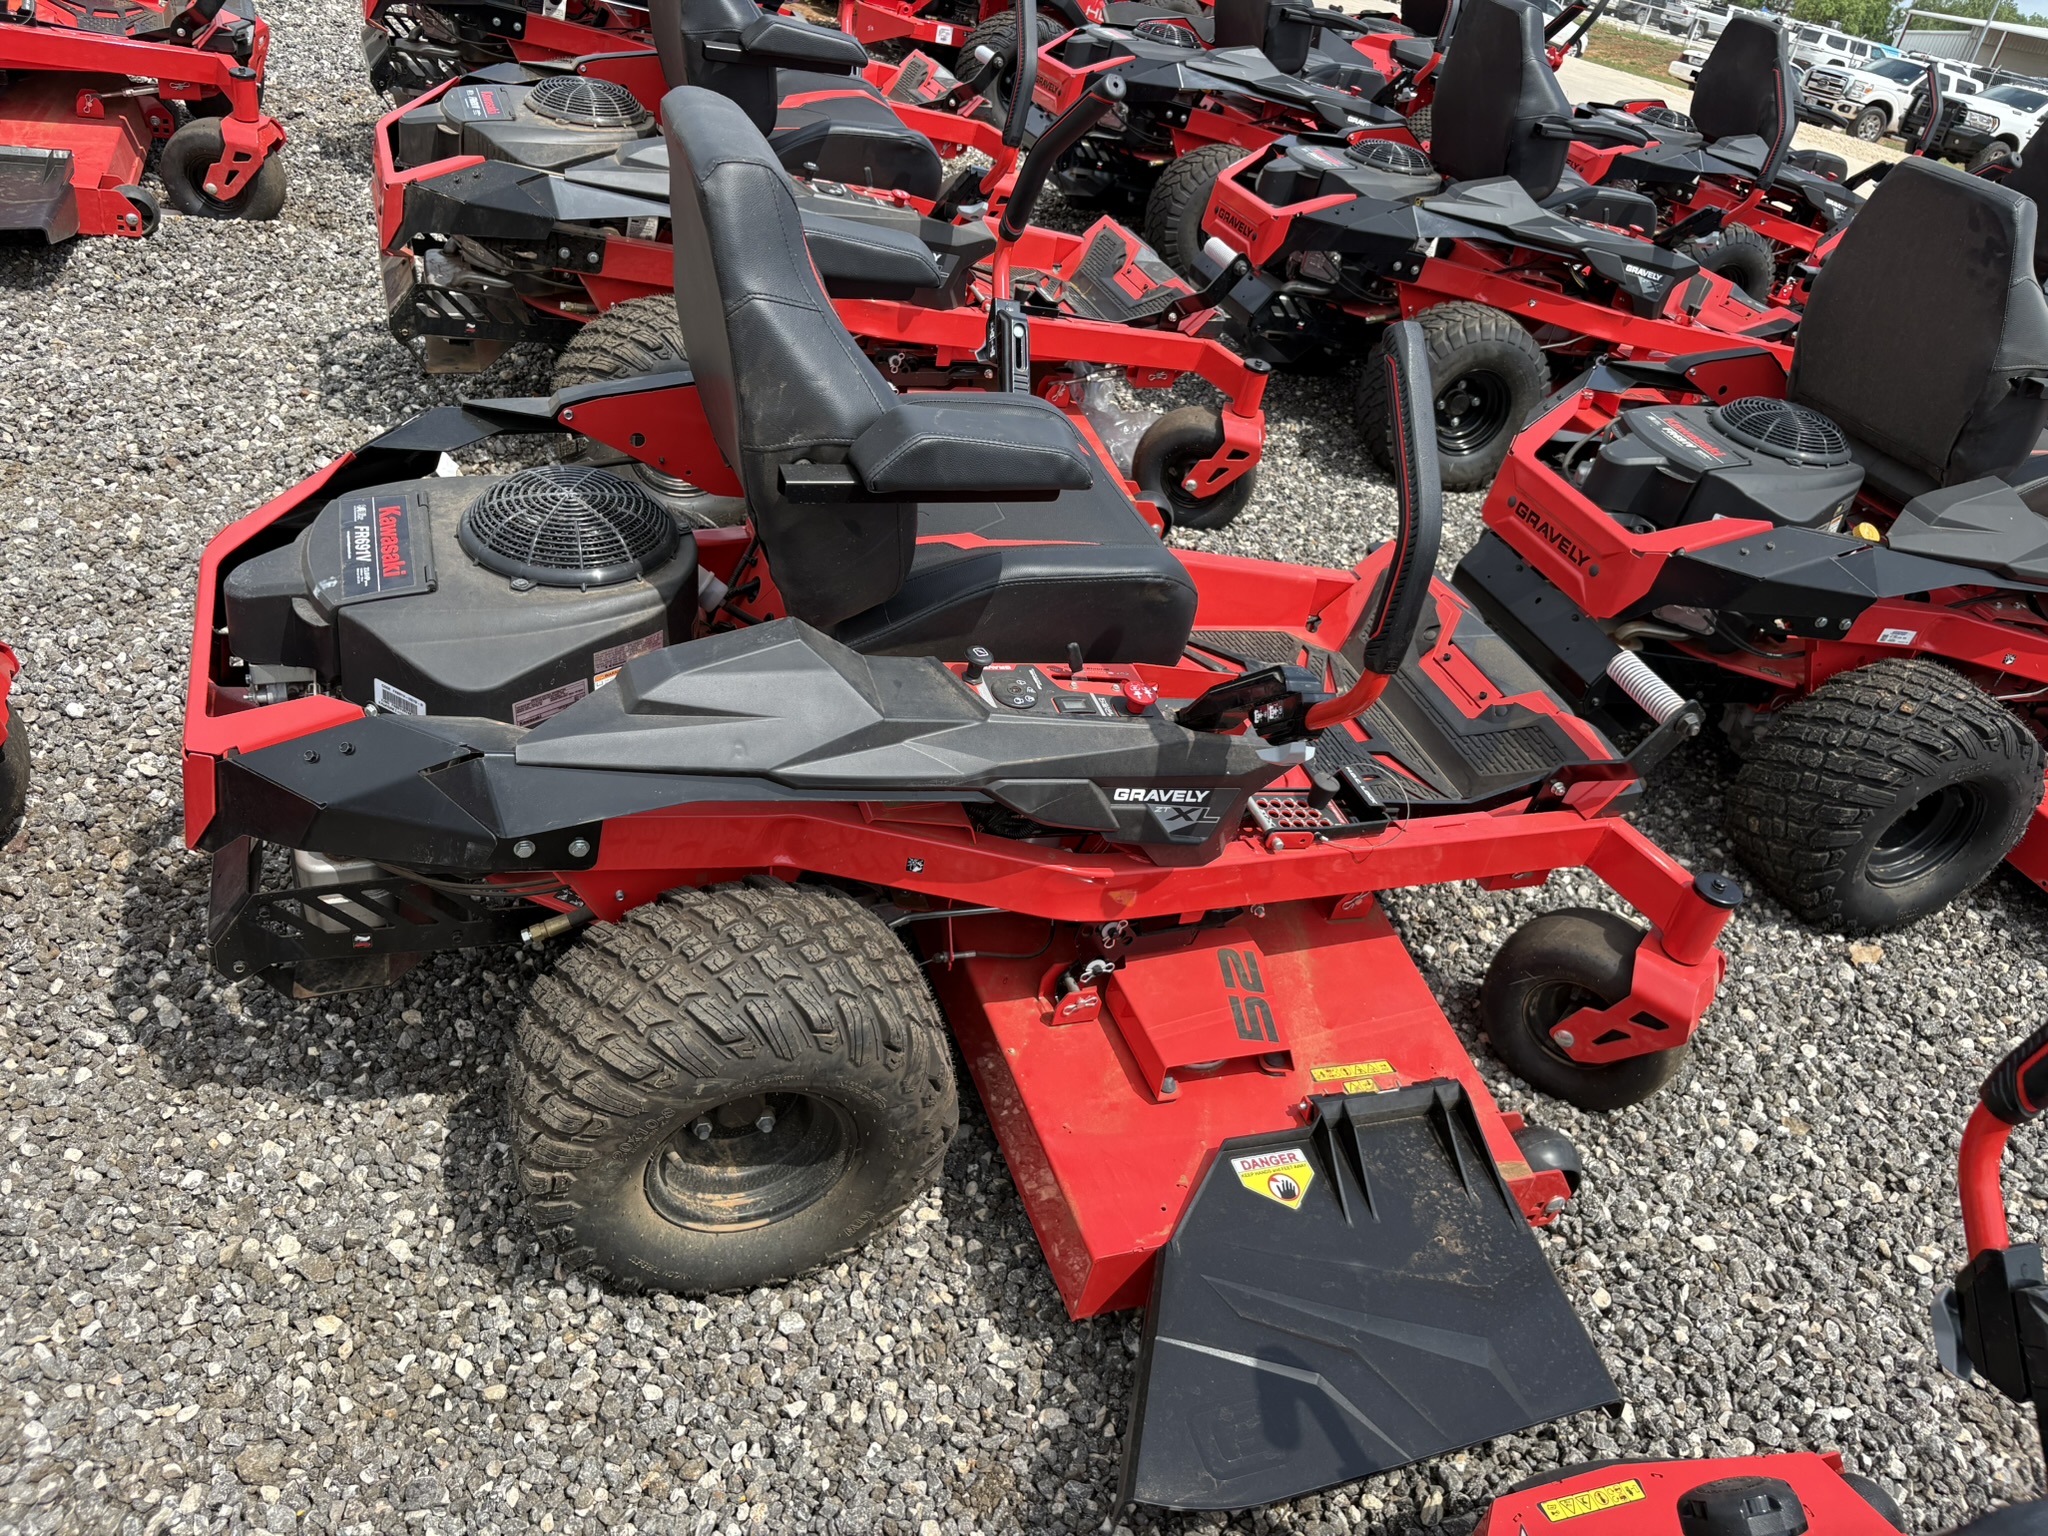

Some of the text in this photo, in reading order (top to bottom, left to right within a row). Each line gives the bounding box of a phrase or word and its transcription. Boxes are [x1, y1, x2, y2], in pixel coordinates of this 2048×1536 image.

[1218, 207, 1254, 238] GRAVELY
[1625, 264, 1664, 281] GRAVELY
[1663, 417, 1728, 457] Kawasaki
[354, 525, 372, 562] FR691V
[378, 505, 408, 578] Kawasaki
[1515, 501, 1591, 568] GRAVELY
[1113, 788, 1210, 803] GRAVELY
[1164, 807, 1221, 824] XL
[1217, 948, 1280, 1043] 52
[1240, 1152, 1300, 1171] DANGER
